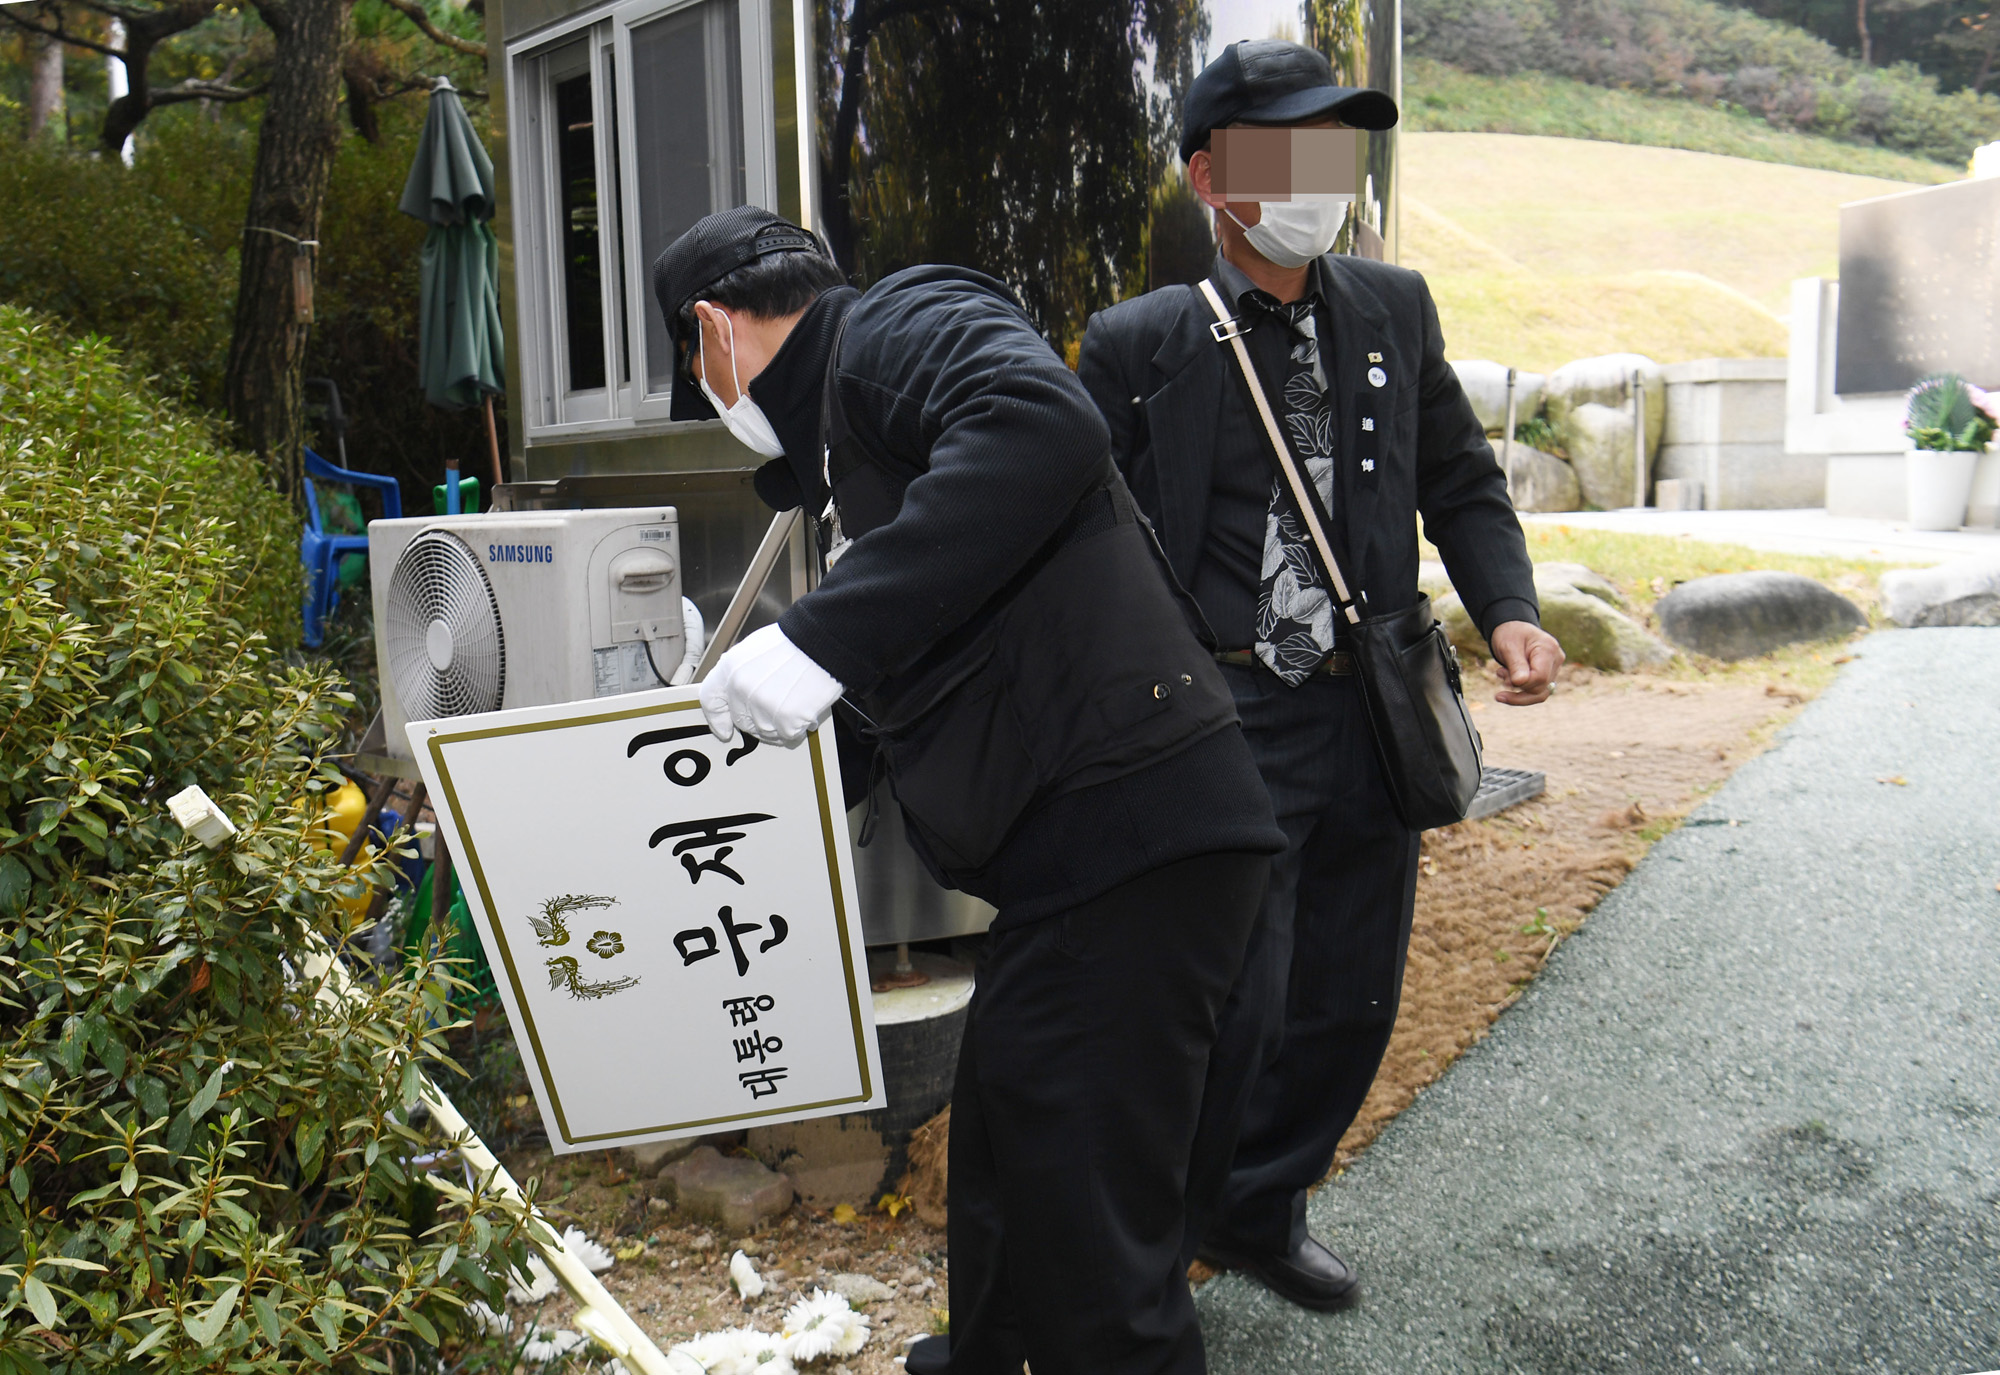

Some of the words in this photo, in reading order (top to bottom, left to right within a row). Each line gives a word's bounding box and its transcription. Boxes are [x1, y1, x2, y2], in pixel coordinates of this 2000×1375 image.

[489, 544, 553, 564] SAMSUNG
[627, 724, 788, 977] 문재인
[723, 994, 788, 1100] 대통령
